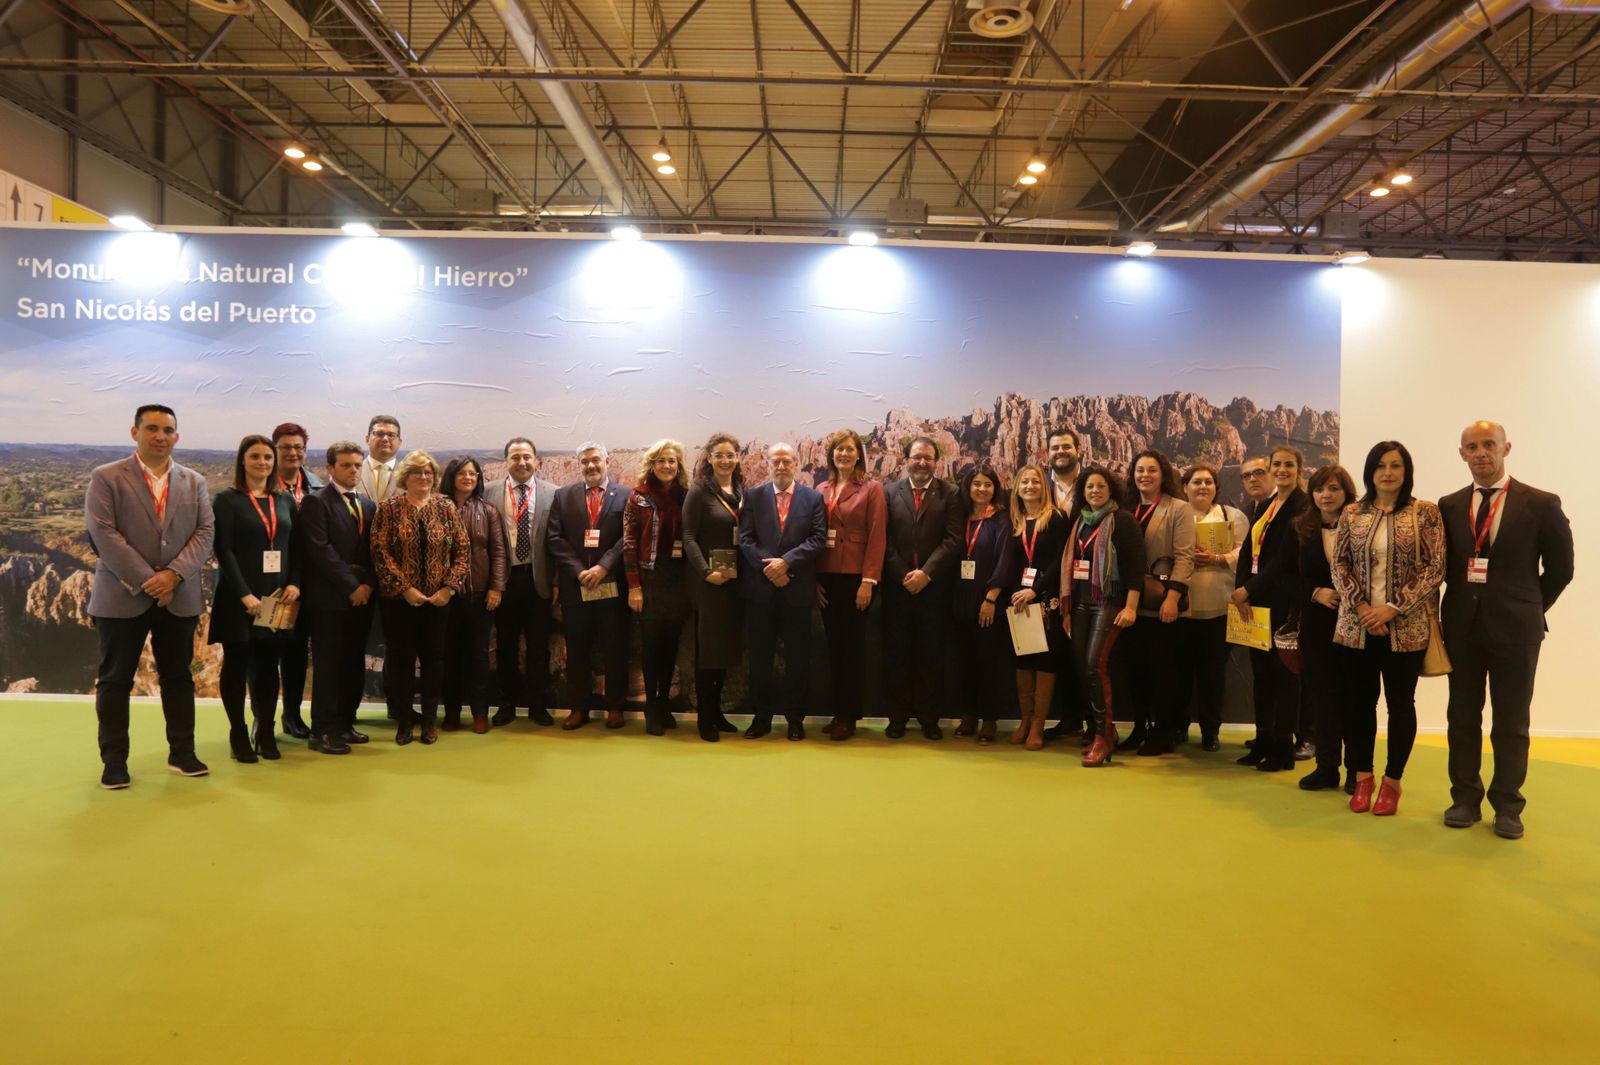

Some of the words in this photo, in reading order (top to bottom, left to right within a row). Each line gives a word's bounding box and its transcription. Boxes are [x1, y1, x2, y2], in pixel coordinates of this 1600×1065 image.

[200, 262, 293, 284] Natural
[434, 266, 528, 288] Hierro”
[17, 297, 65, 319] San
[75, 298, 171, 322] Nicolás
[179, 300, 219, 322] del
[230, 302, 317, 325] Puerto
